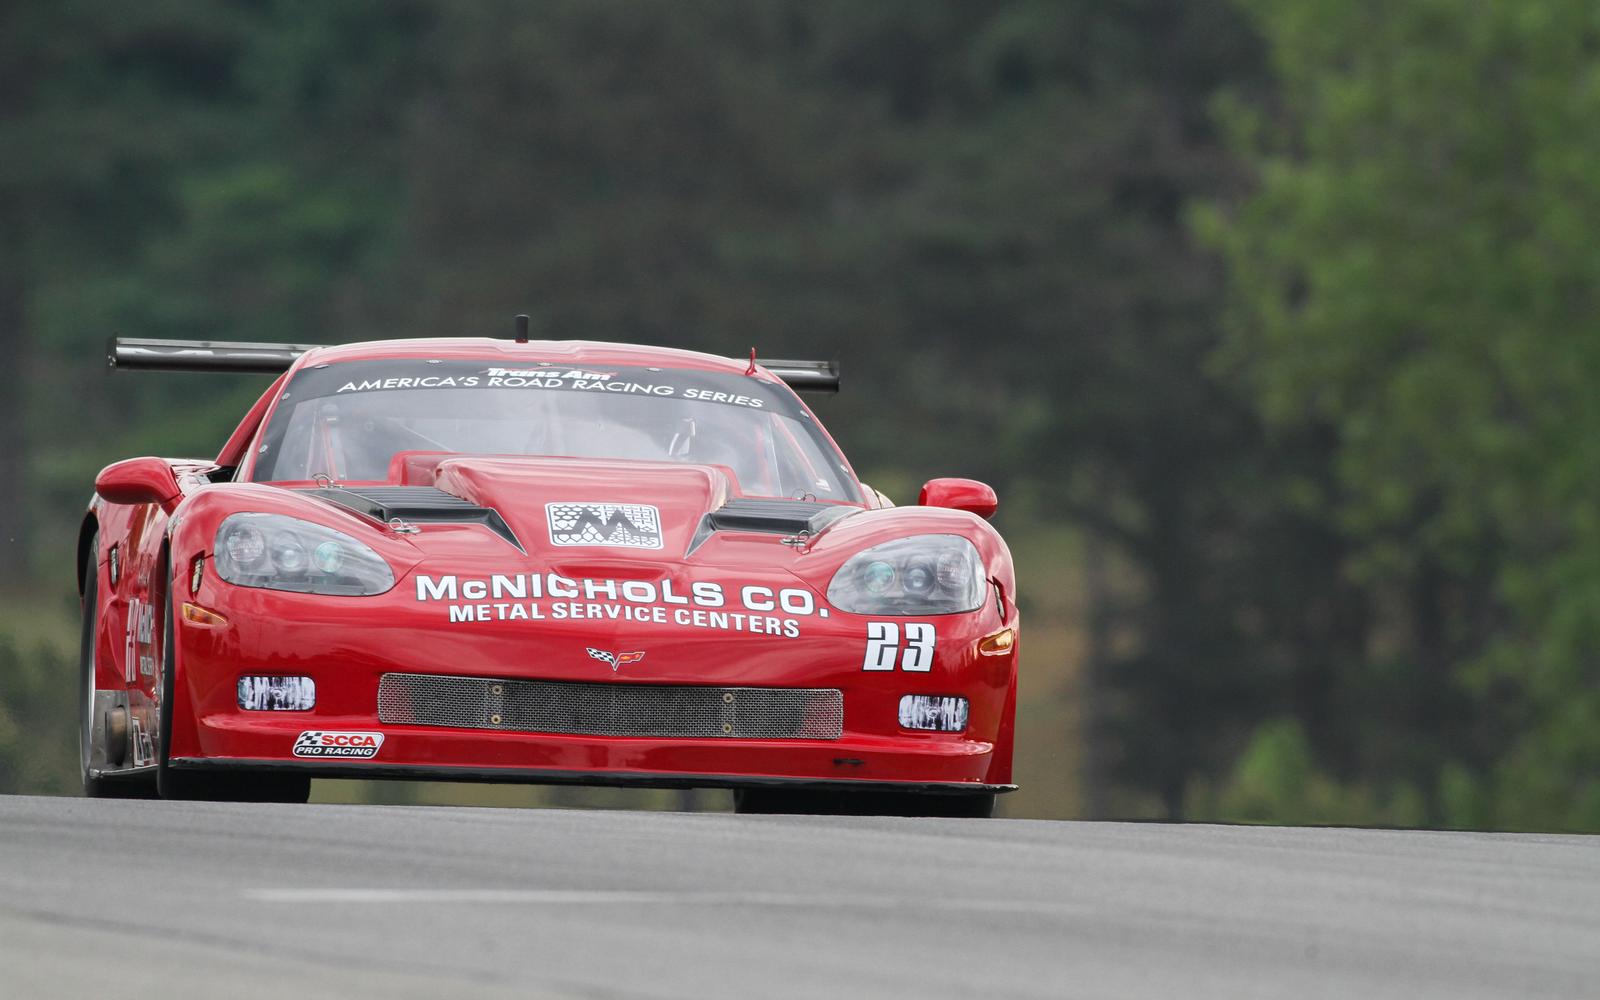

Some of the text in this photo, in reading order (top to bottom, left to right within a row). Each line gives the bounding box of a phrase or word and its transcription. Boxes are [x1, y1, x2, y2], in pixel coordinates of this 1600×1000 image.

[337, 376, 764, 408] AMERICA'S ROAD RACING SERIES
[415, 573, 830, 618] McNICHOLS CO.
[449, 602, 801, 639] METAL SERVICE CENTERS
[862, 621, 936, 672] 23
[296, 746, 374, 756] PRO RACING
[321, 735, 376, 746] SCCA
